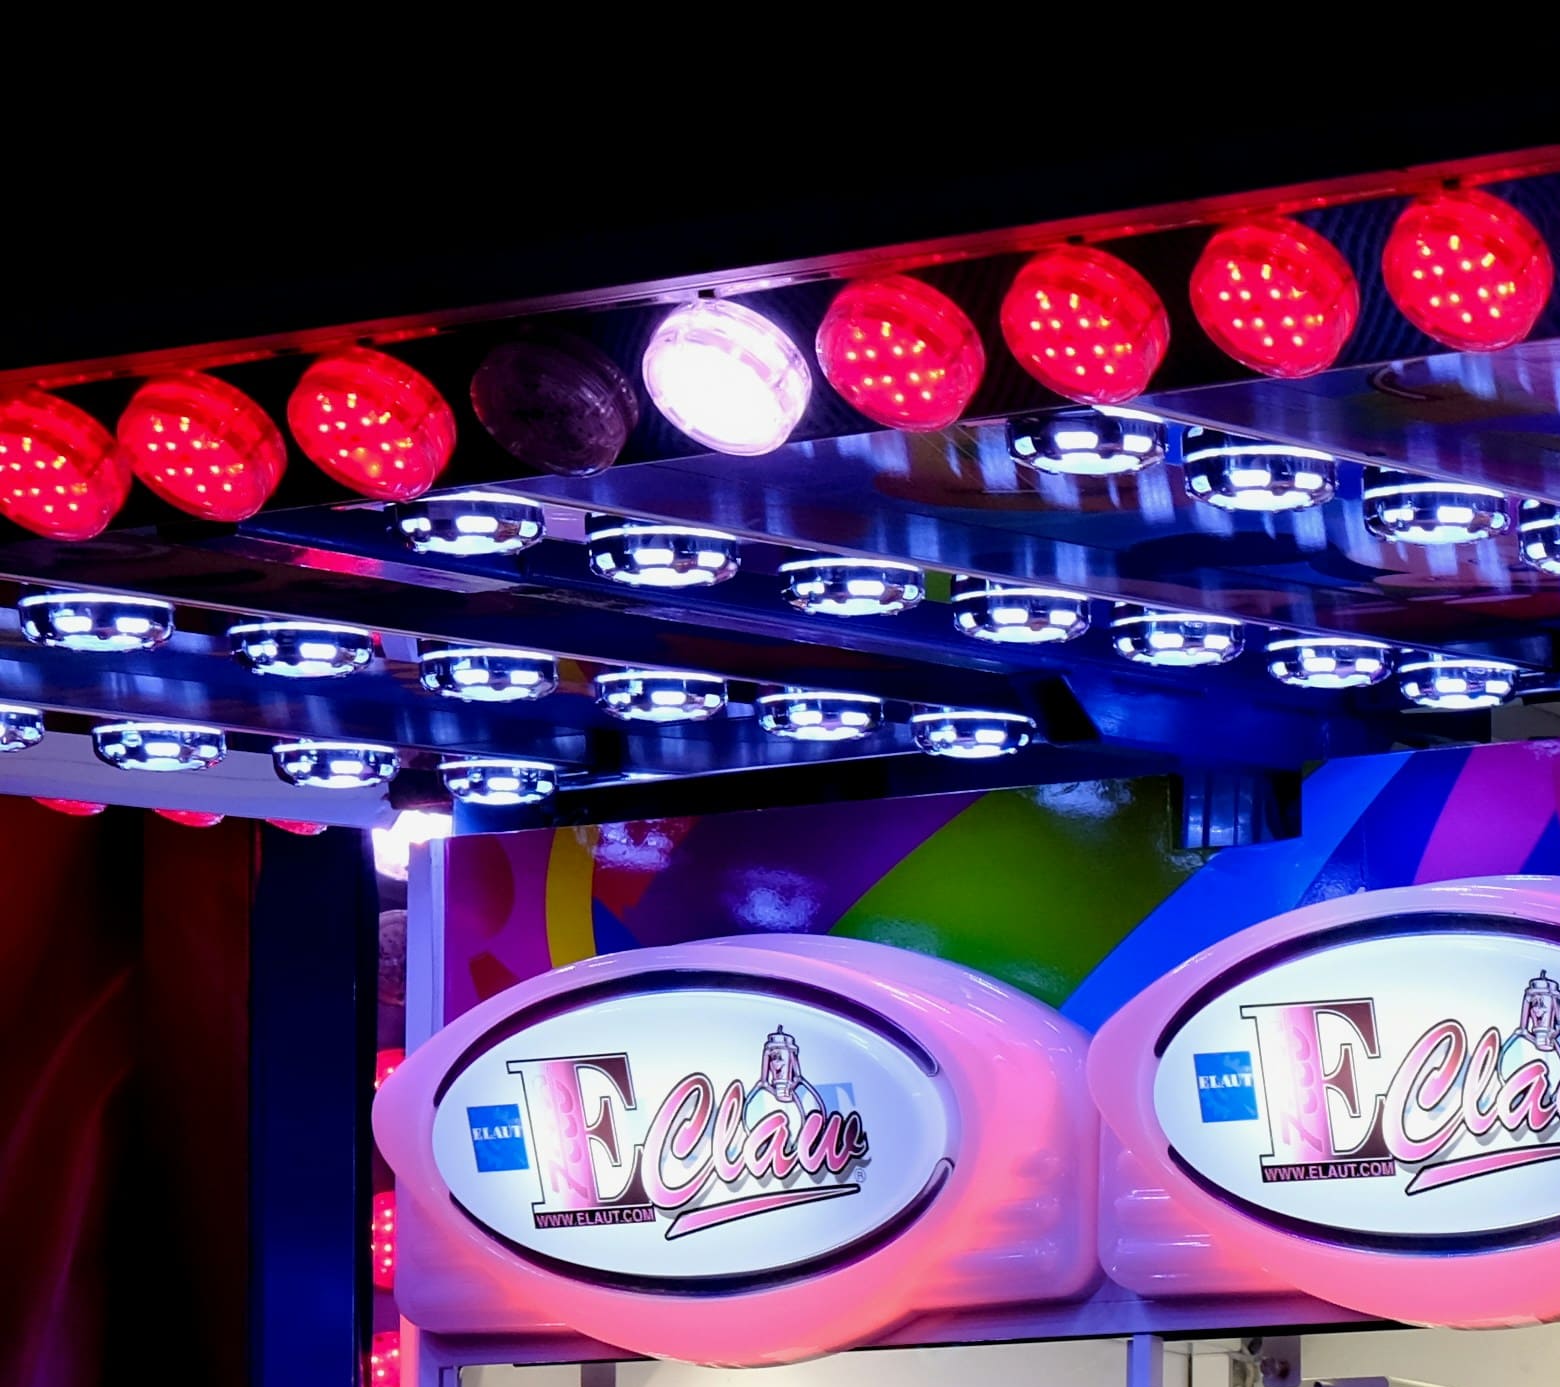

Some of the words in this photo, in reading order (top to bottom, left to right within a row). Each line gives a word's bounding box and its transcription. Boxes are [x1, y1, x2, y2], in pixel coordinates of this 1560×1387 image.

[1199, 1075, 1253, 1089] ELAUT
[472, 1124, 523, 1140] ELAUT
[1263, 1163, 1395, 1182] WWW.ELAUT.COM
[535, 1210, 656, 1228] WWW.ELAUT.COM
